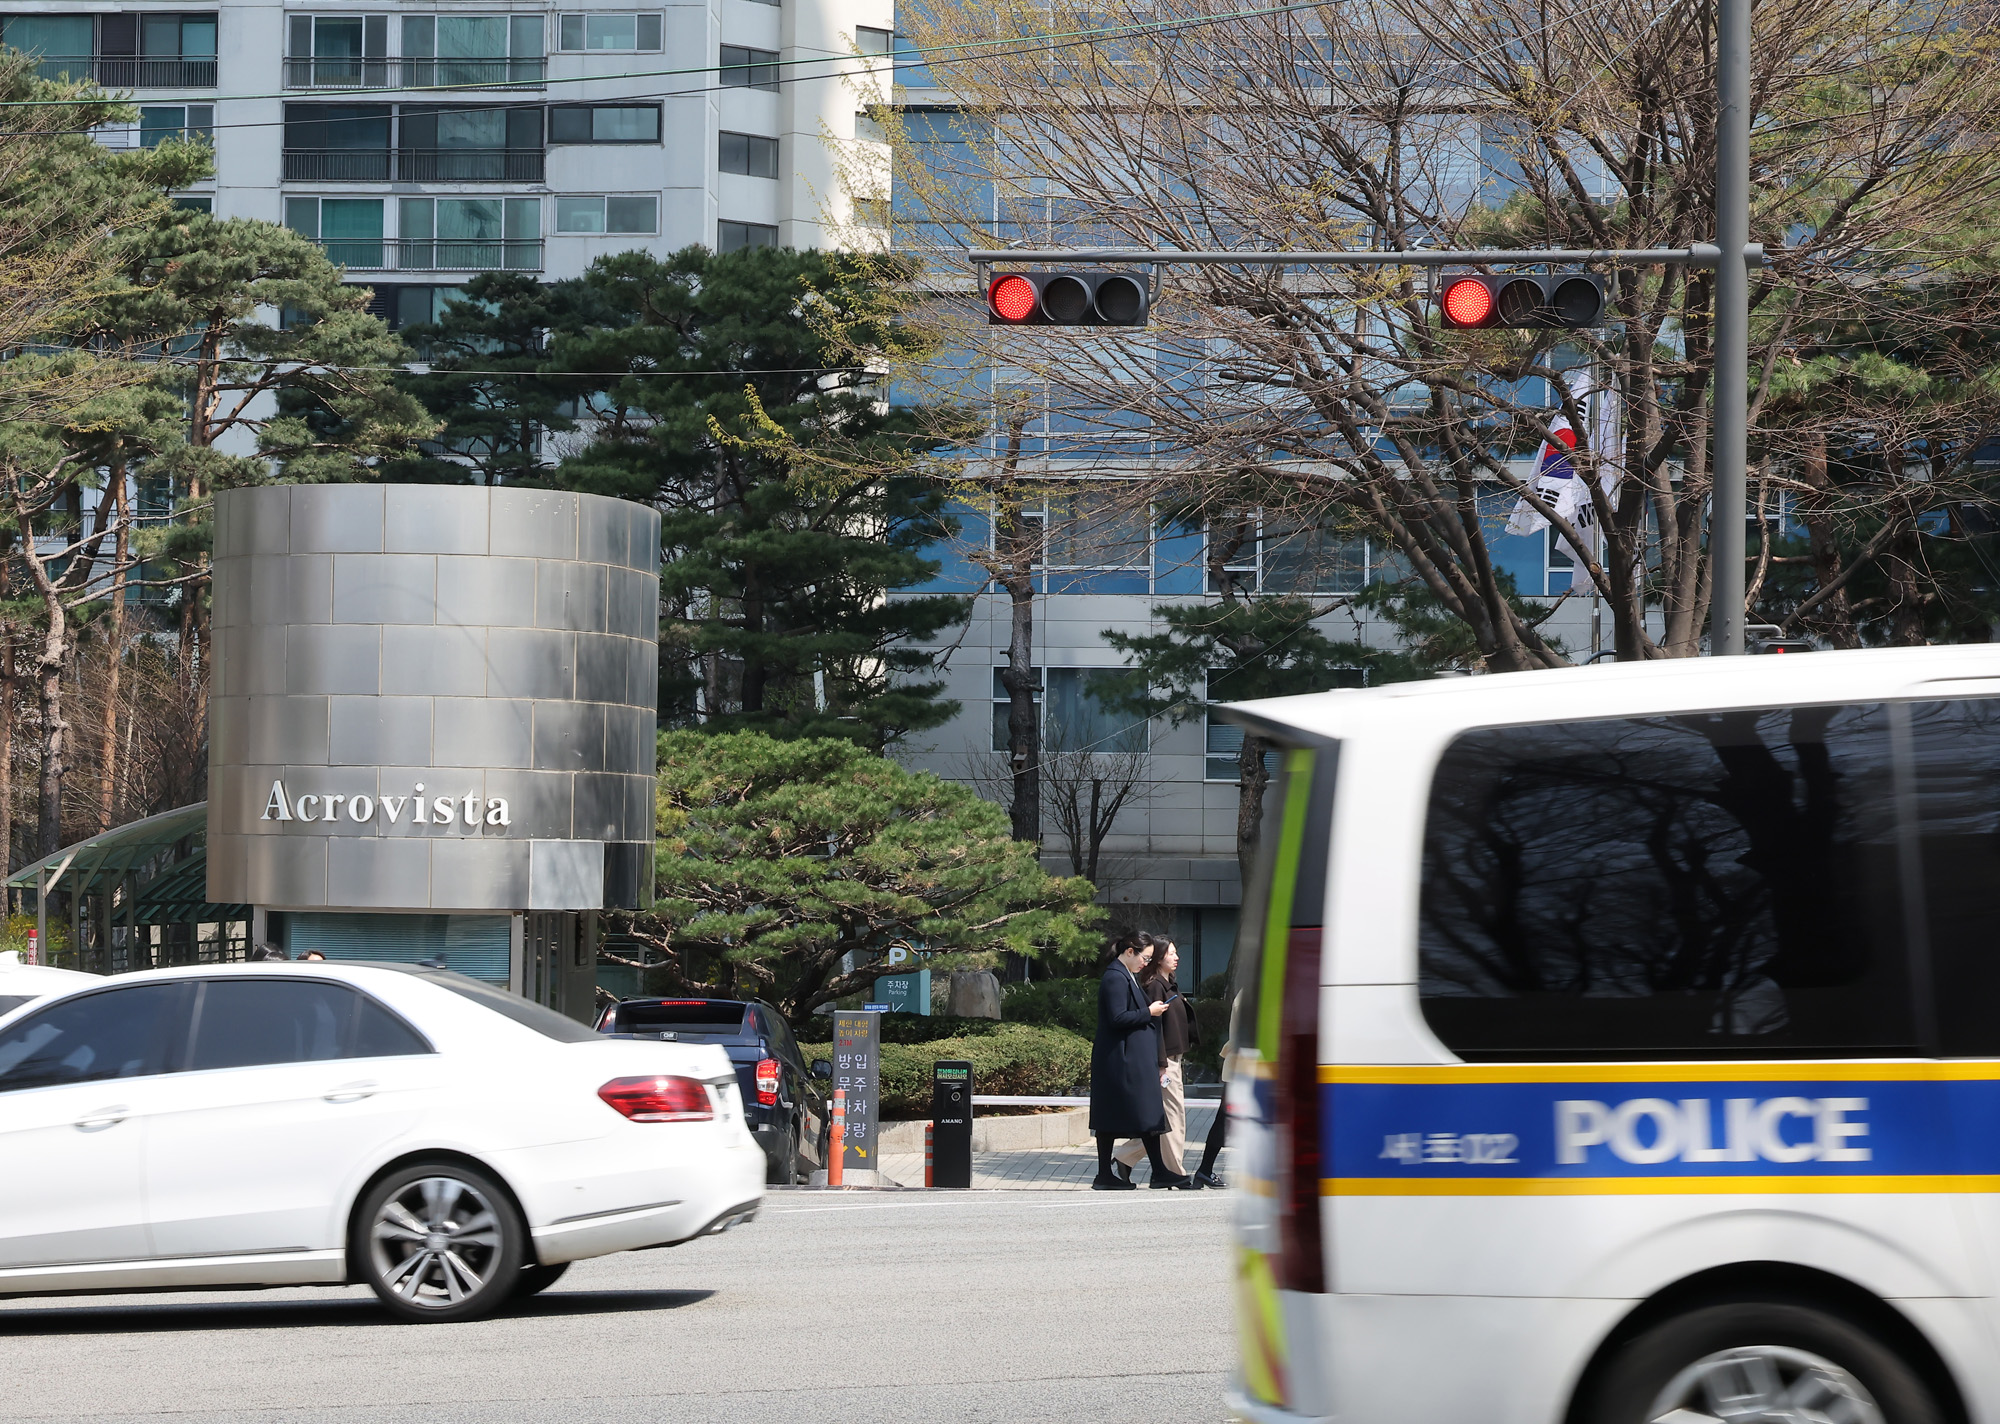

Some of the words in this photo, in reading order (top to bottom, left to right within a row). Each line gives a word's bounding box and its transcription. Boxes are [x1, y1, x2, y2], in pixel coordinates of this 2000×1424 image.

[260, 779, 512, 826] Acrovista
[889, 947, 907, 965] P
[888, 980, 908, 989] 주차장
[1553, 1097, 1873, 1165] POLICE
